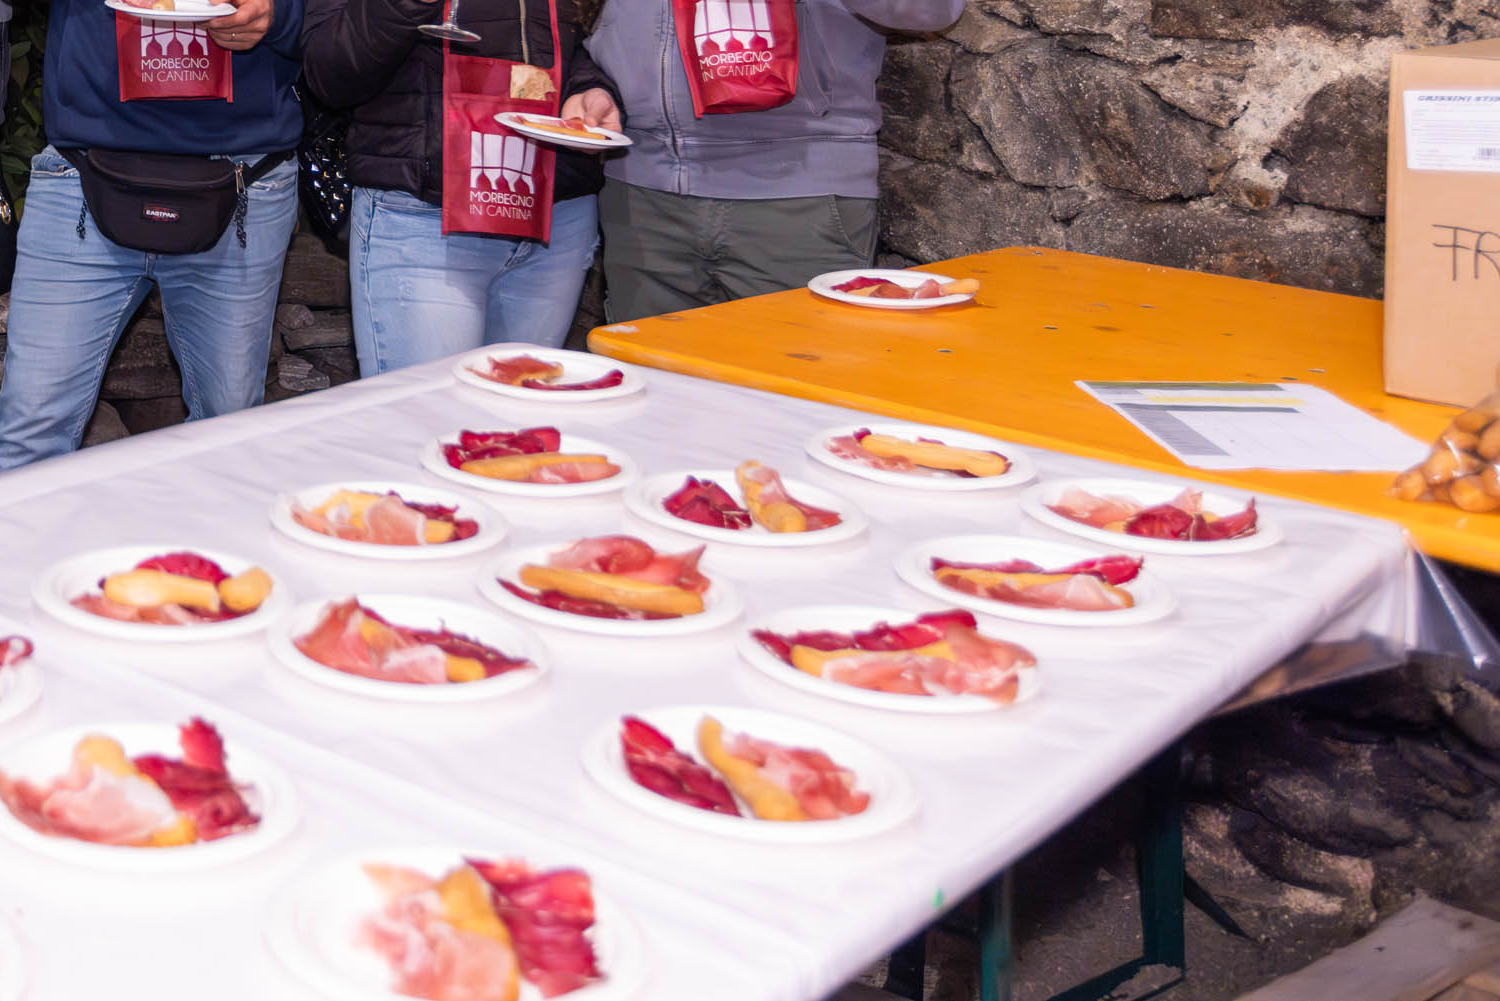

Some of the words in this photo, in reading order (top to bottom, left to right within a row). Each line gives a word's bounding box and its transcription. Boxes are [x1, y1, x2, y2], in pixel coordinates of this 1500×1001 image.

[141, 57, 210, 71] MORBEGNO
[700, 51, 773, 70] MORBEGNO
[141, 72, 154, 83] IN
[157, 70, 210, 83] CANTINA
[702, 71, 715, 83] IN
[717, 62, 772, 79] CANTINA
[469, 190, 534, 208] MORBEGNO
[469, 204, 483, 217] IN
[486, 205, 533, 220] CANTINA
